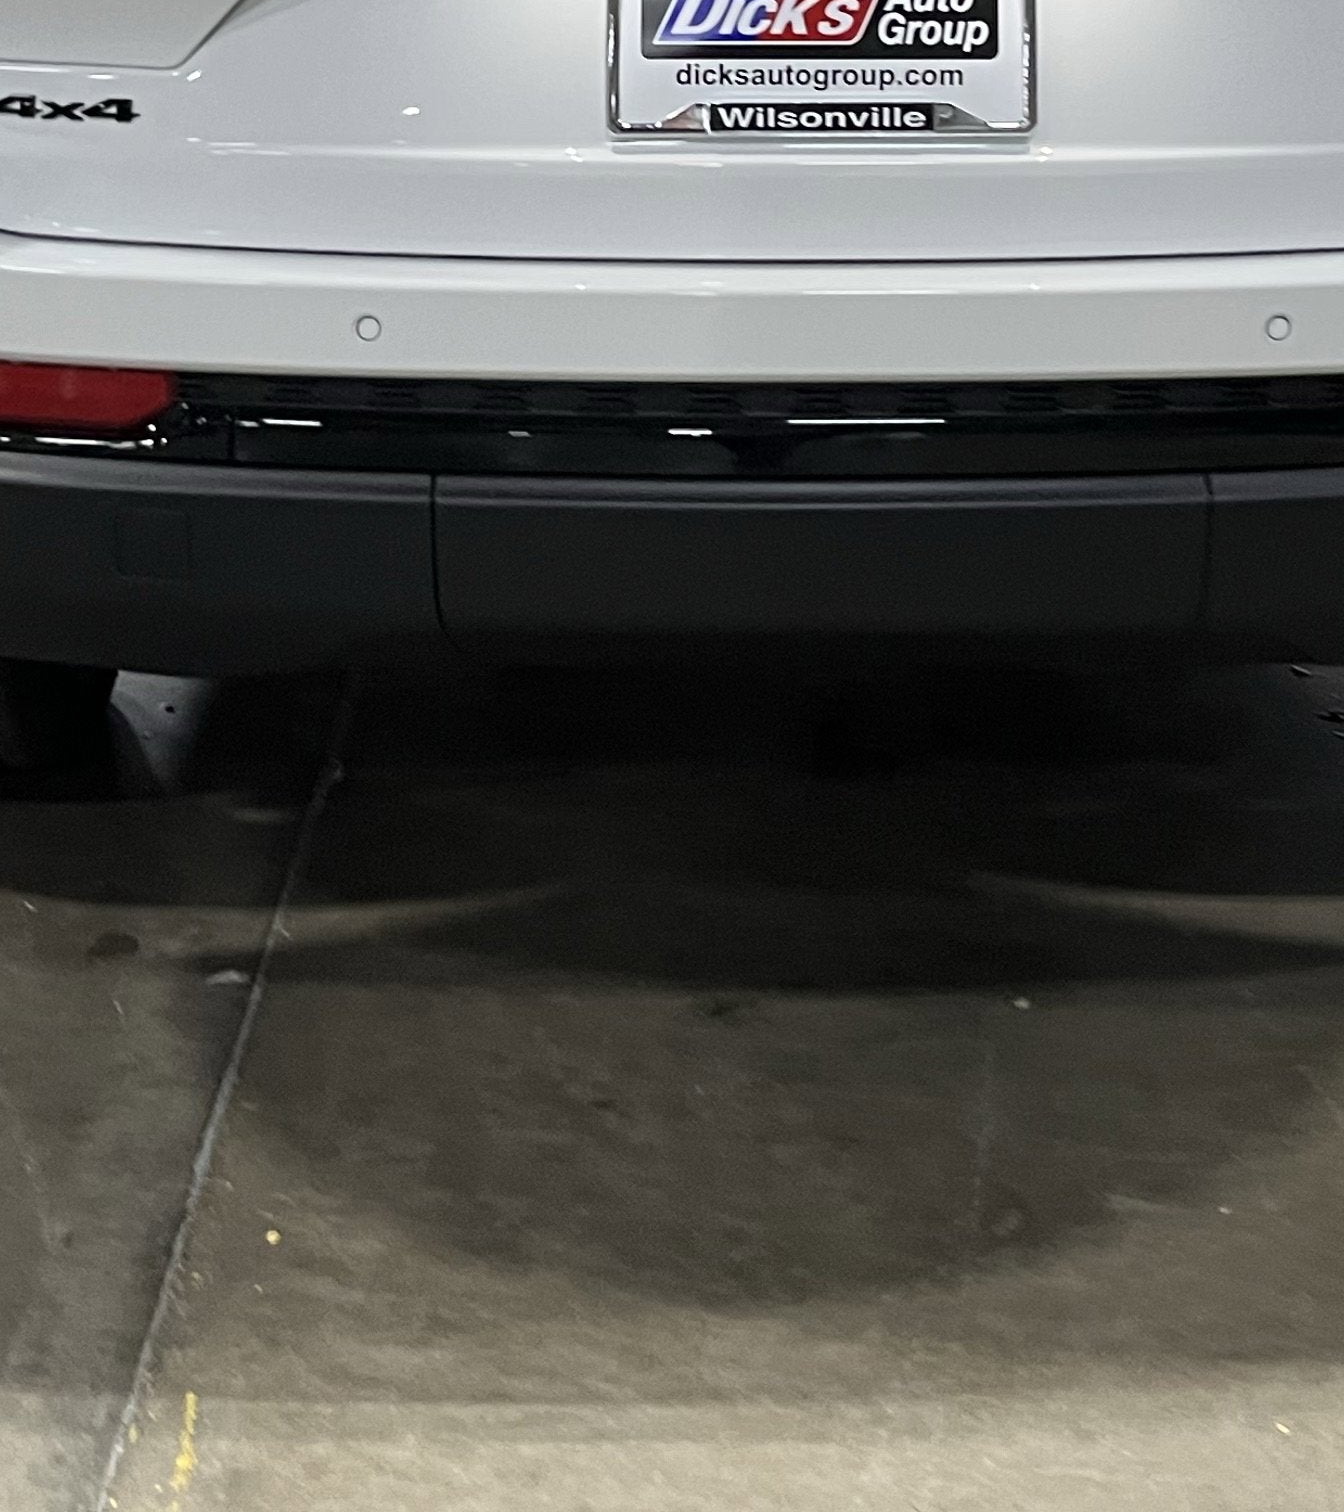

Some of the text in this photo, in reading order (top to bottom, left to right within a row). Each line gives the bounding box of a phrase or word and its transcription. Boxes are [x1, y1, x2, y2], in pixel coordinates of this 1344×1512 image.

[878, 13, 990, 53] Group
[676, 64, 964, 91] dicksautogroup.com
[718, 106, 927, 129] Wilsonville
